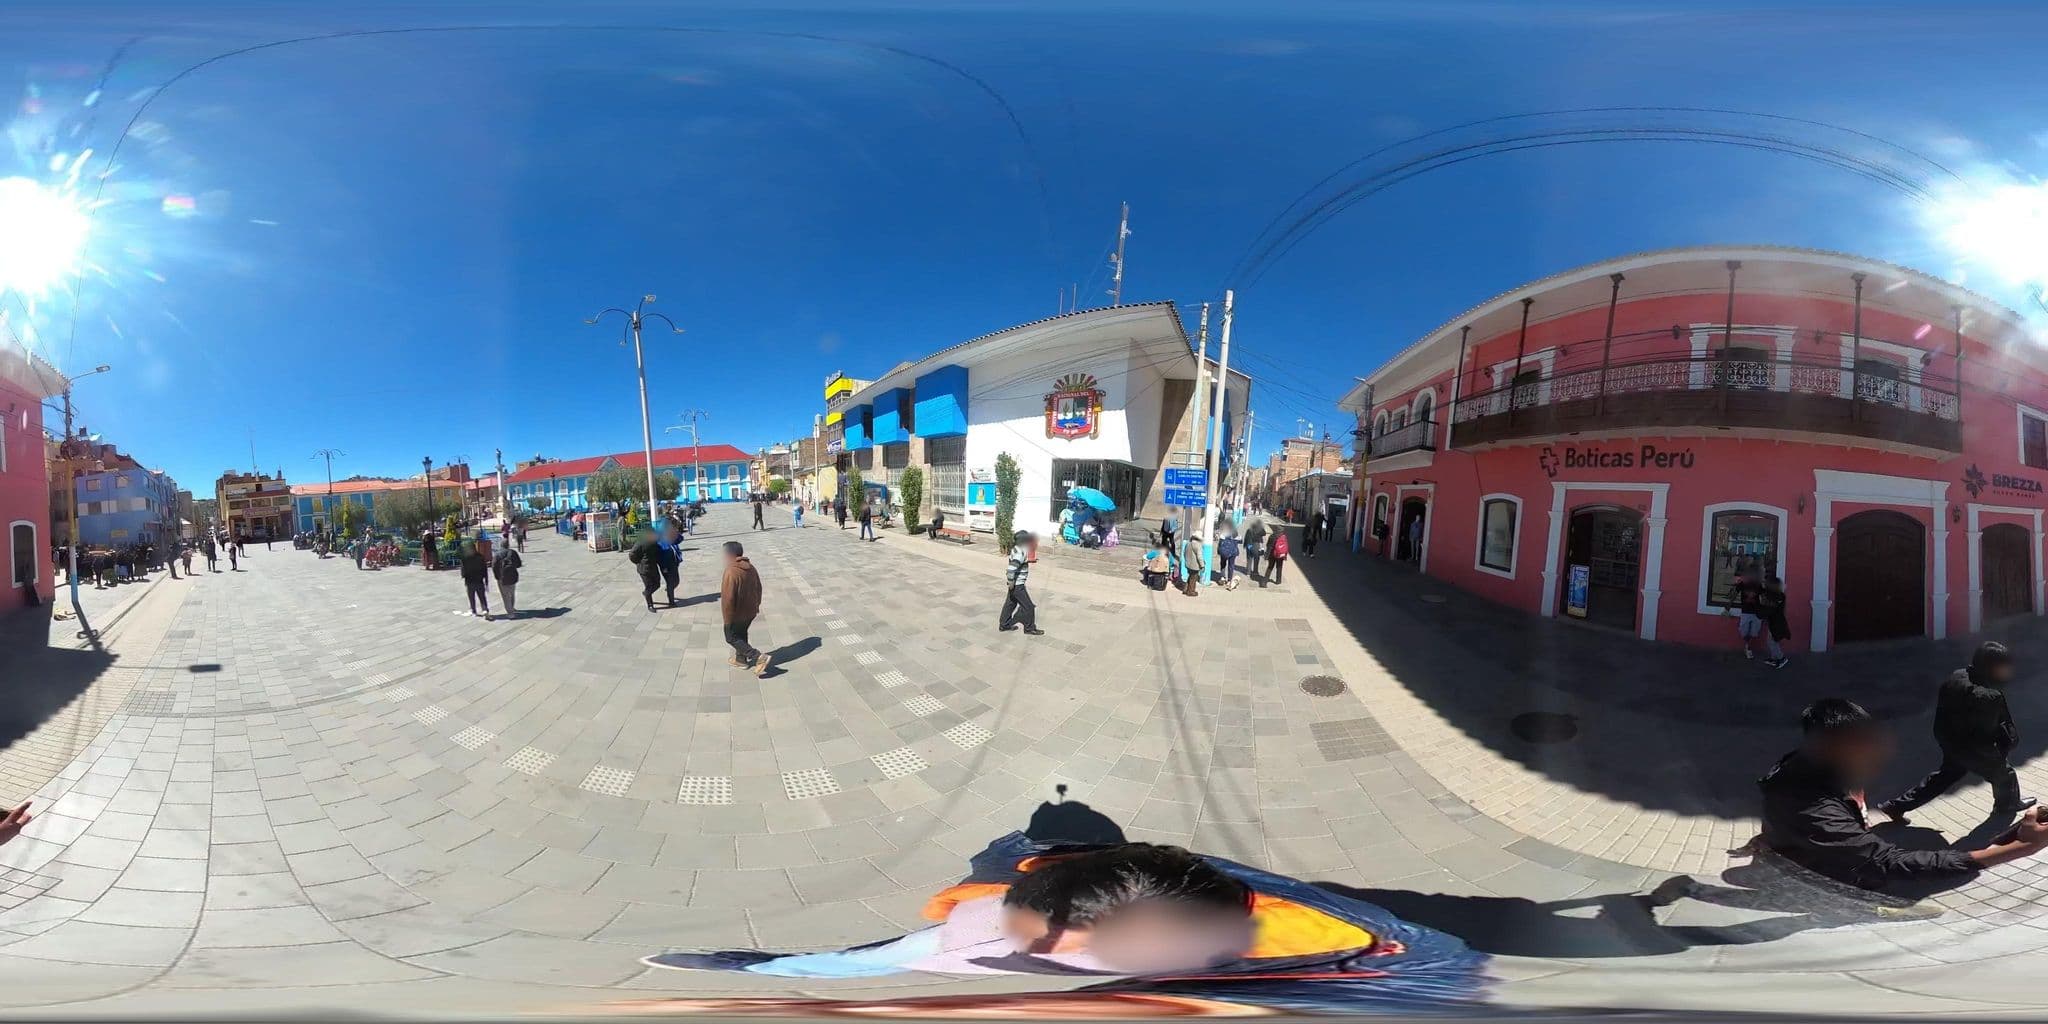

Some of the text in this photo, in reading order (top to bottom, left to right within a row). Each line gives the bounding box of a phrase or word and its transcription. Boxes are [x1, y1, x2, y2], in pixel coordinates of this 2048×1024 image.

[1565, 445, 1694, 468] Boticas Perú
[1992, 474, 2043, 493] BREZZA
